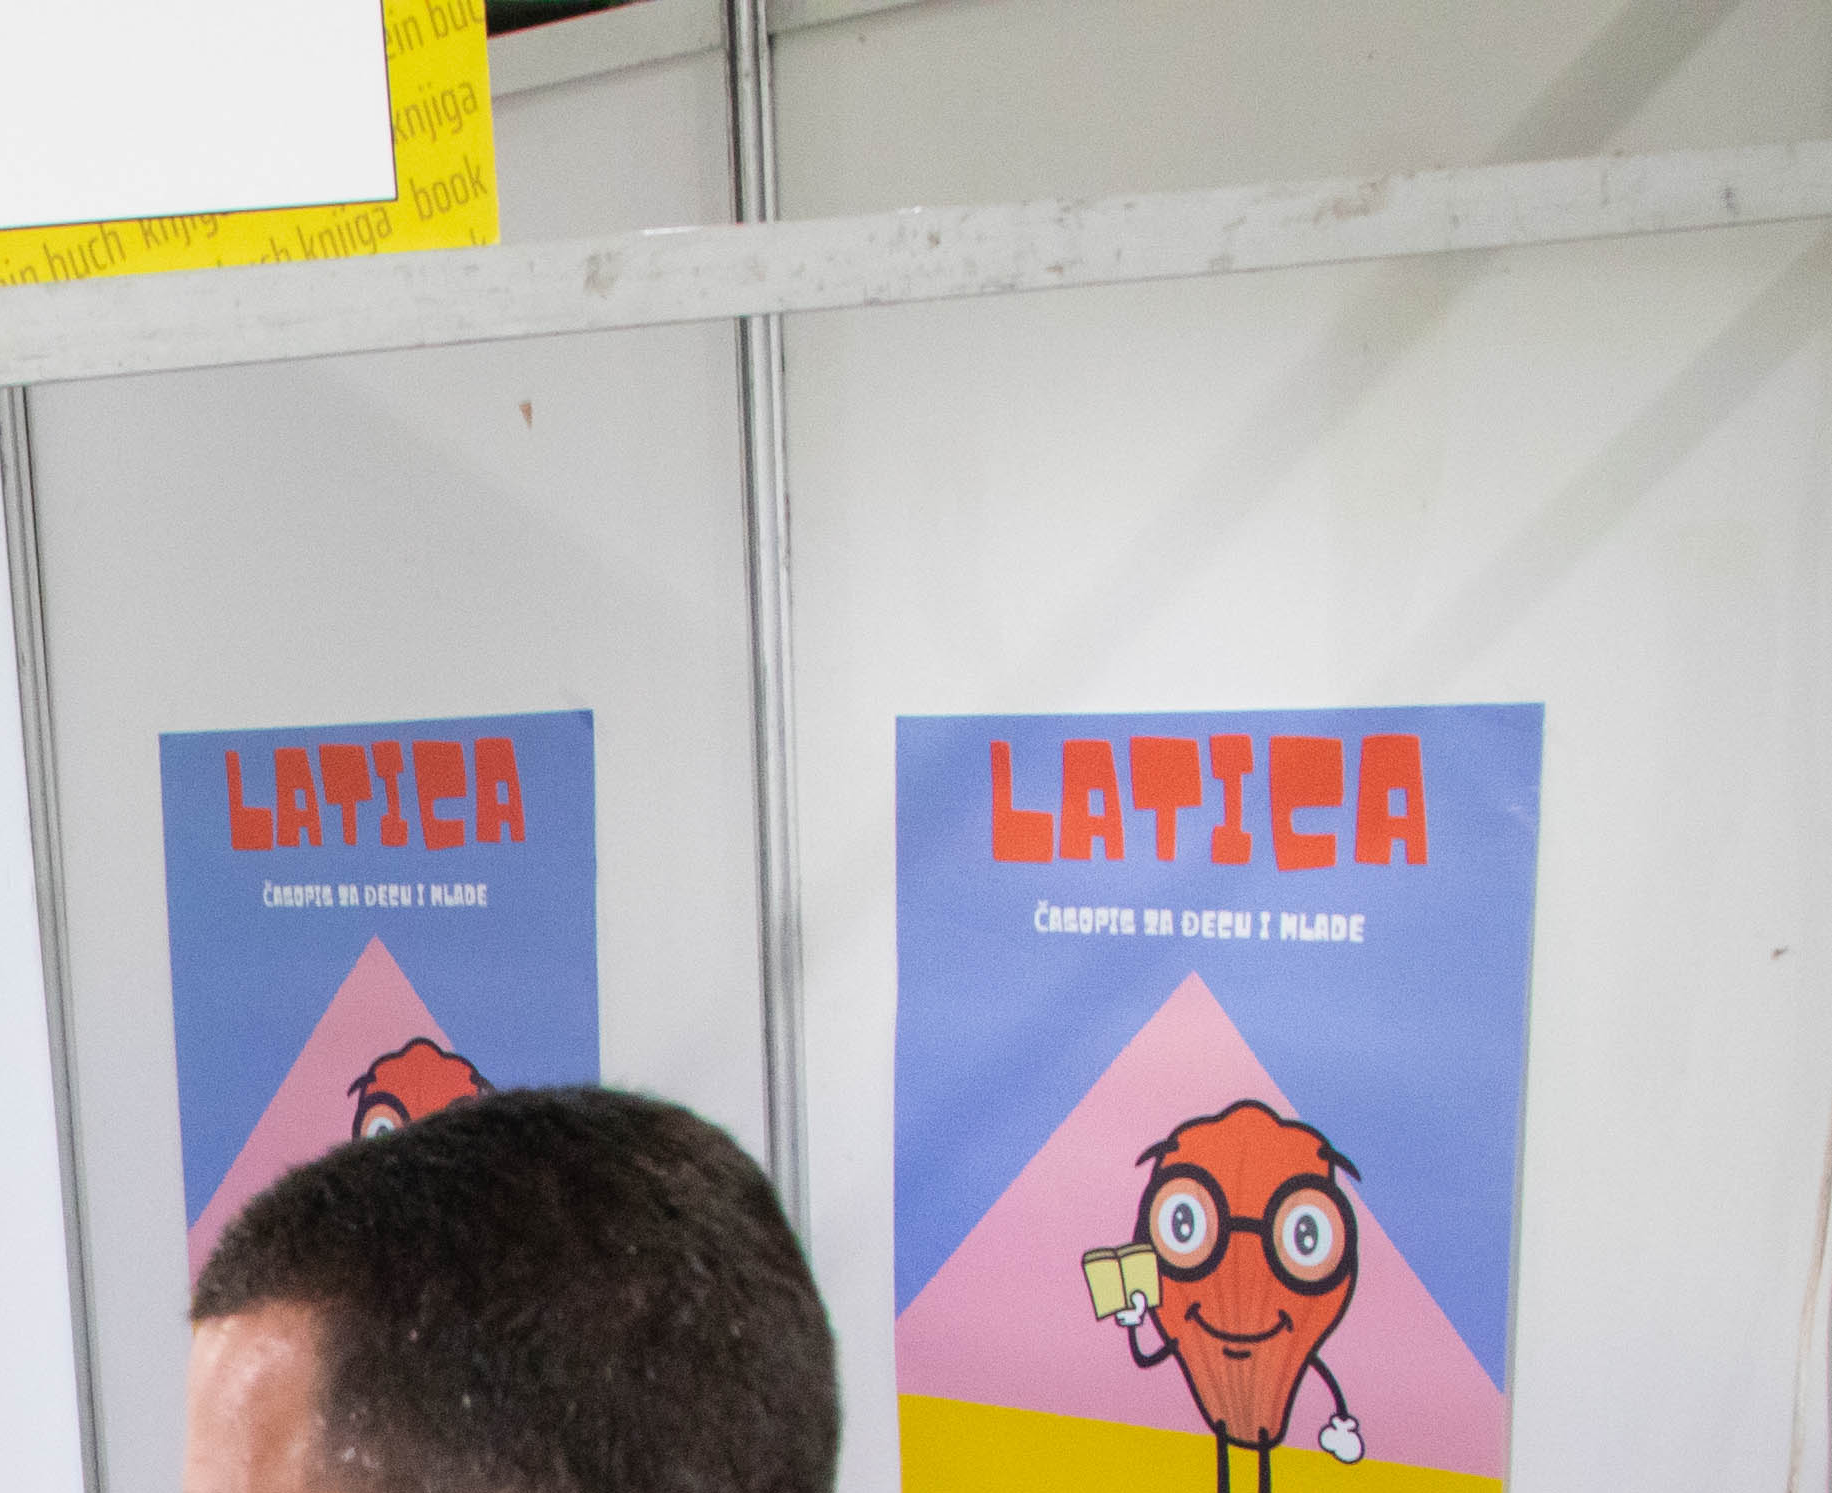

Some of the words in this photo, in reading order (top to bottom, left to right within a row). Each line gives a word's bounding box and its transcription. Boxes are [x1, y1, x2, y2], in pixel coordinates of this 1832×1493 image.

[412, 155, 489, 223] book
[225, 738, 526, 851] LATICA
[990, 733, 1428, 872] LATICA
[416, 884, 425, 906] I
[1259, 911, 1270, 940] I
